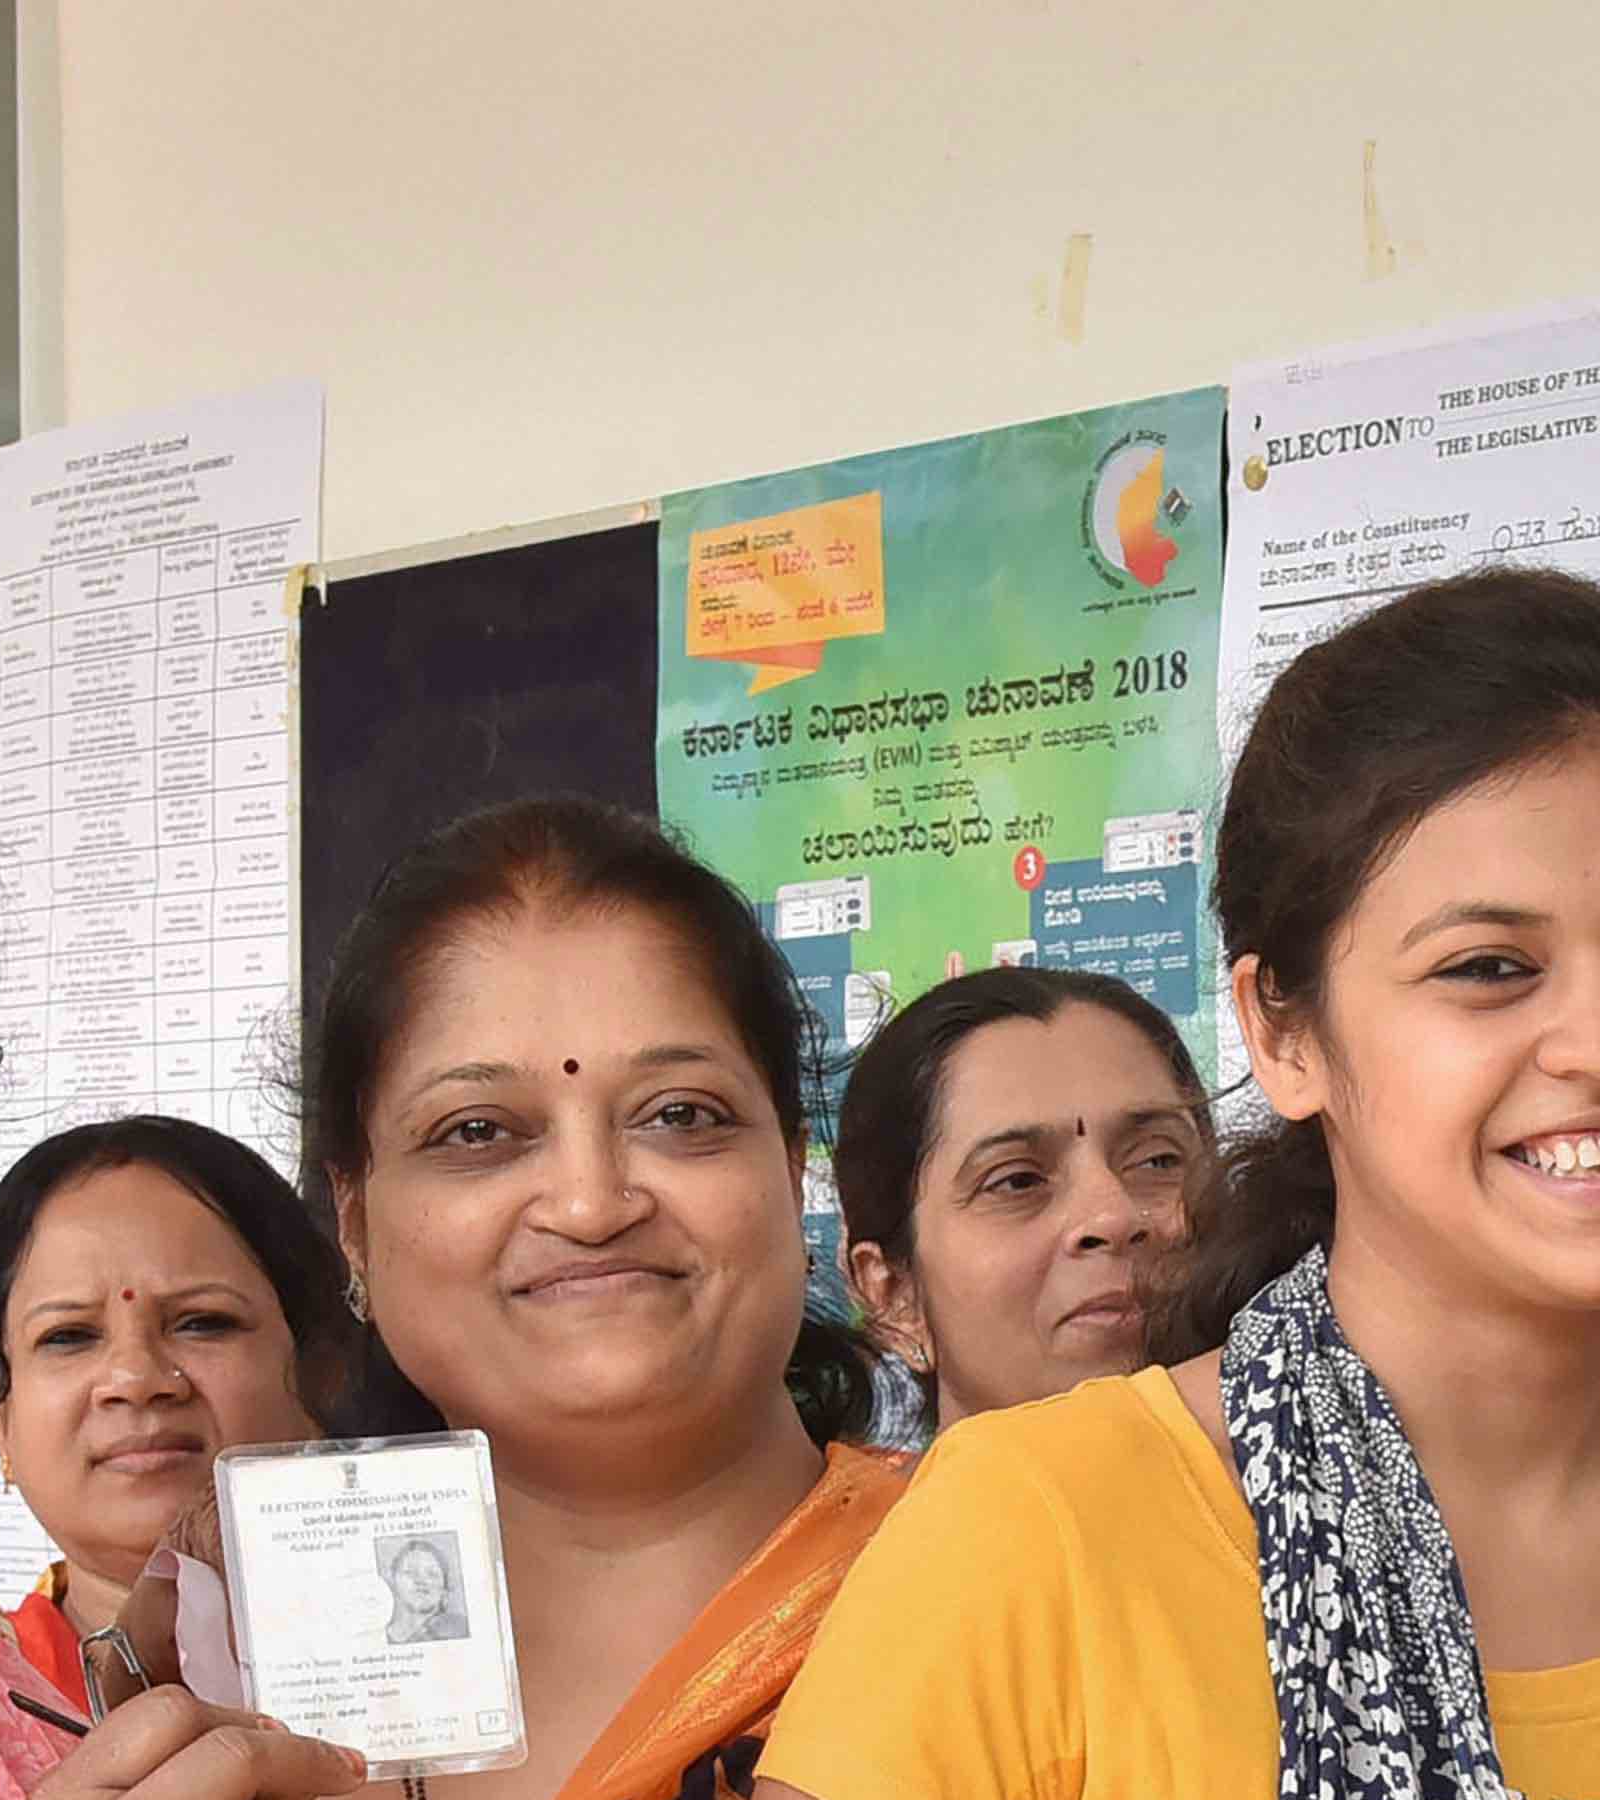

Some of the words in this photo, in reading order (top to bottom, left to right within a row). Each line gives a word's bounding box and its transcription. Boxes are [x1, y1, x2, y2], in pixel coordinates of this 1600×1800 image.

[1438, 390, 1473, 411] THE
[1478, 378, 1540, 403] HOUSE
[1545, 372, 1569, 391] OF
[1266, 416, 1403, 466] ELECTION
[1406, 416, 1435, 439] TO
[1435, 436, 1472, 458] THE
[1476, 415, 1597, 452] LEGISLATIVE
[1263, 538, 1307, 557] Name
[1311, 531, 1328, 549] of
[1332, 527, 1357, 546] the
[1363, 512, 1470, 542] Constituency
[1256, 630, 1300, 648] Name
[683, 705, 793, 758] ಕರ್ನಾಟಕ
[808, 687, 950, 745] ವಿಧಾನಸಭಾ
[966, 658, 1095, 718] ಚುನಾವಣೆ
[1113, 650, 1188, 699] 2018
[873, 741, 923, 774] (EVM)
[802, 812, 994, 866] ಚಲಾಯಿಸುವುದು
[1022, 852, 1038, 881] 3
